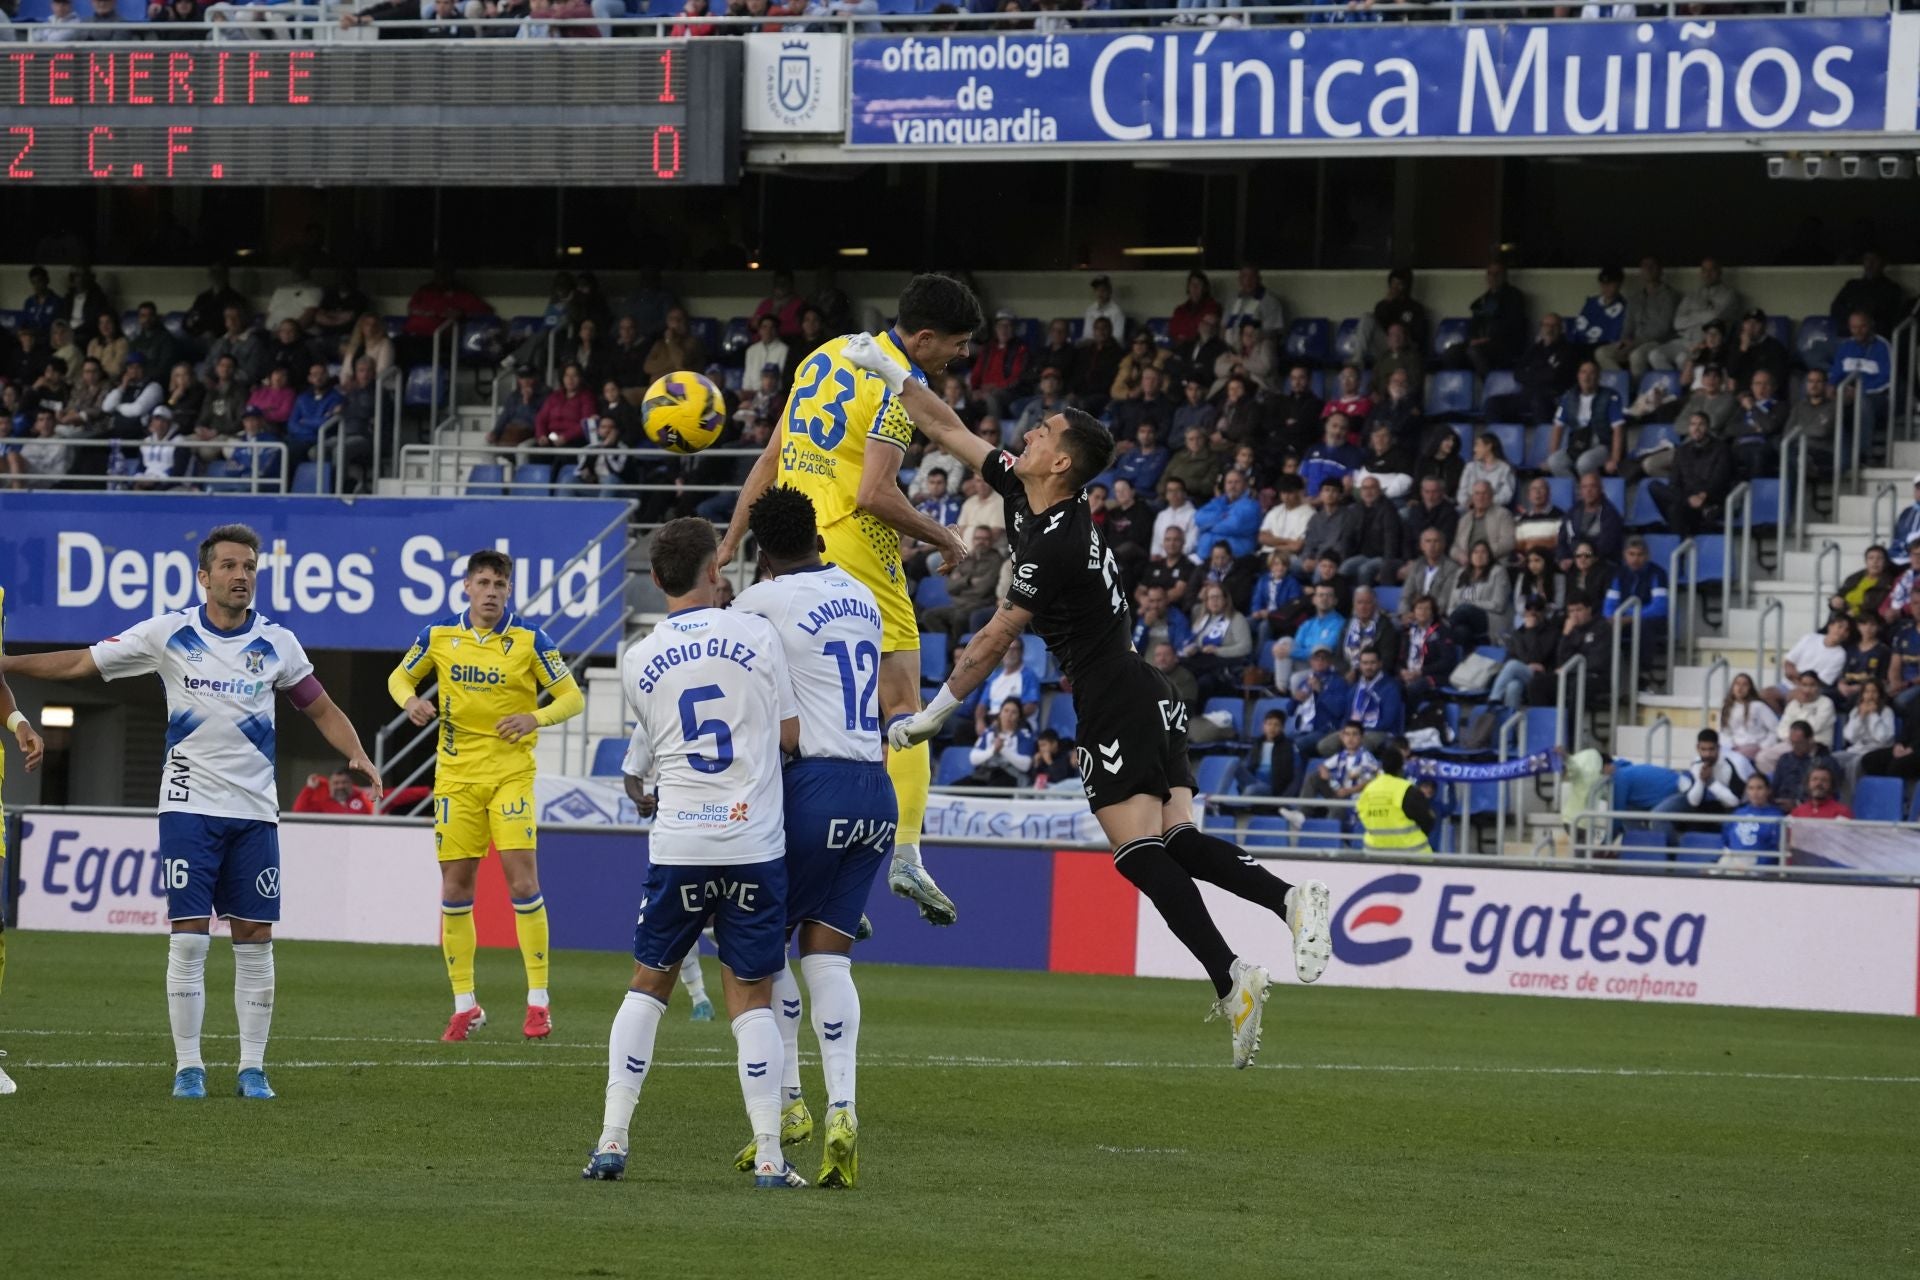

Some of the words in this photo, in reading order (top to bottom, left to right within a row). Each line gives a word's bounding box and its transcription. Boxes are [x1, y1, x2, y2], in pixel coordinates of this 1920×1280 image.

[10, 52, 315, 104] TENERIFE
[658, 49, 676, 103] 1
[882, 35, 1070, 78] oftalmología
[956, 76, 993, 111] de
[1089, 31, 1420, 140] Clínica
[1457, 20, 1856, 135] Muiños
[892, 108, 1058, 144] vanguardia
[652, 125, 680, 179] 0
[789, 352, 856, 451] 23
[797, 598, 881, 636] LANDAZURI
[639, 642, 702, 694] SERGIO
[706, 638, 757, 672] GLEZ.
[822, 640, 878, 732] 12
[462, 683, 492, 693] Telecom
[678, 683, 734, 775] 5
[677, 811, 728, 822] Canarias
[702, 803, 729, 813] Islas
[164, 858, 188, 889] 16
[107, 907, 159, 925] carnes
[1431, 884, 1707, 975] Egatesa
[1509, 971, 1568, 990] carnes
[1575, 971, 1599, 991] de
[1604, 973, 1698, 1000] confianza
